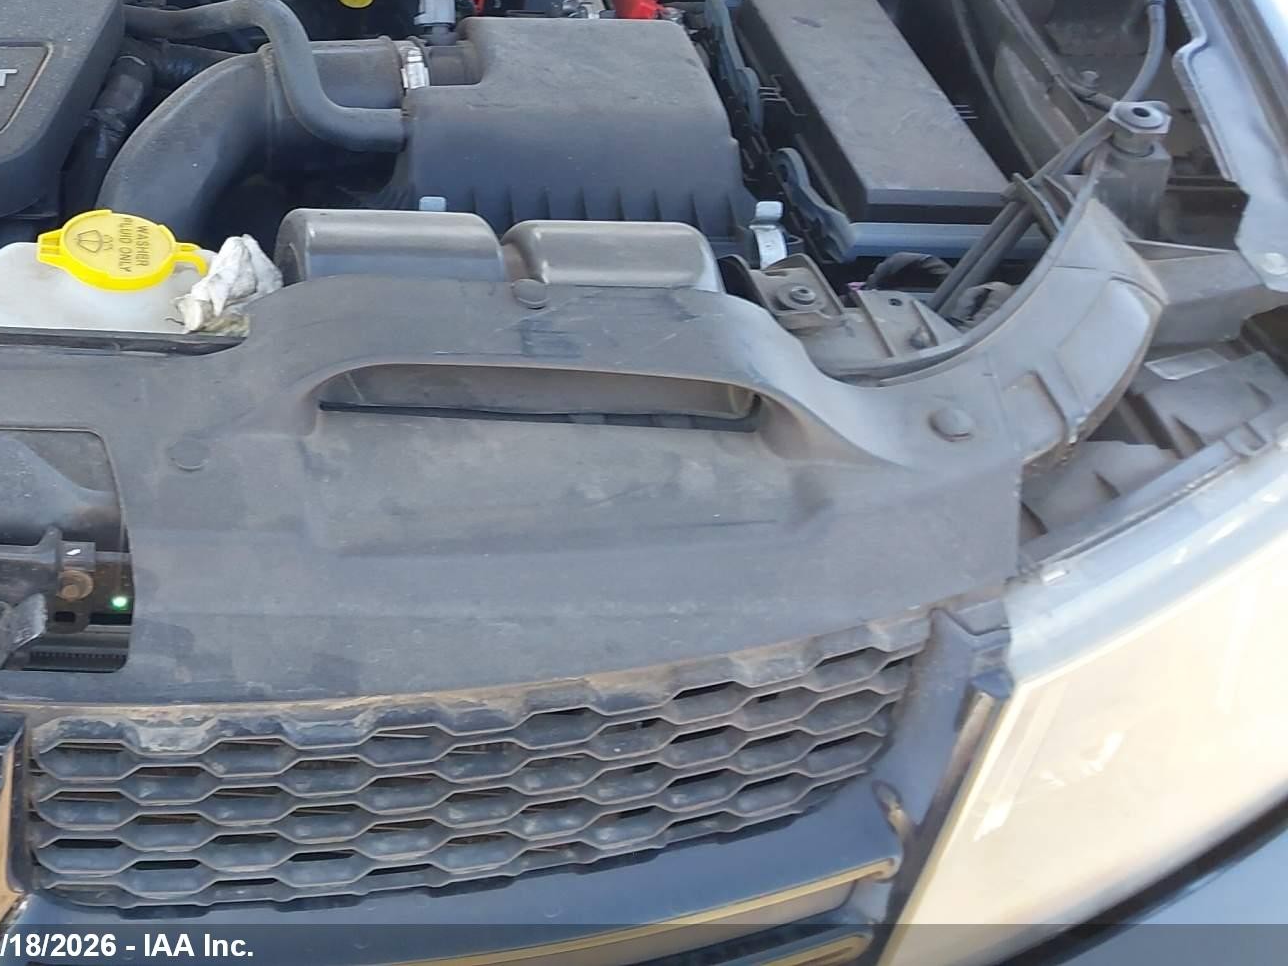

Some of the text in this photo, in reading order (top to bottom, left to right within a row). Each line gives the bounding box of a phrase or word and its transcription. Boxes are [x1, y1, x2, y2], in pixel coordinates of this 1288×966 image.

[119, 217, 133, 273] FLUID ONLY
[135, 225, 151, 267] WASHER
